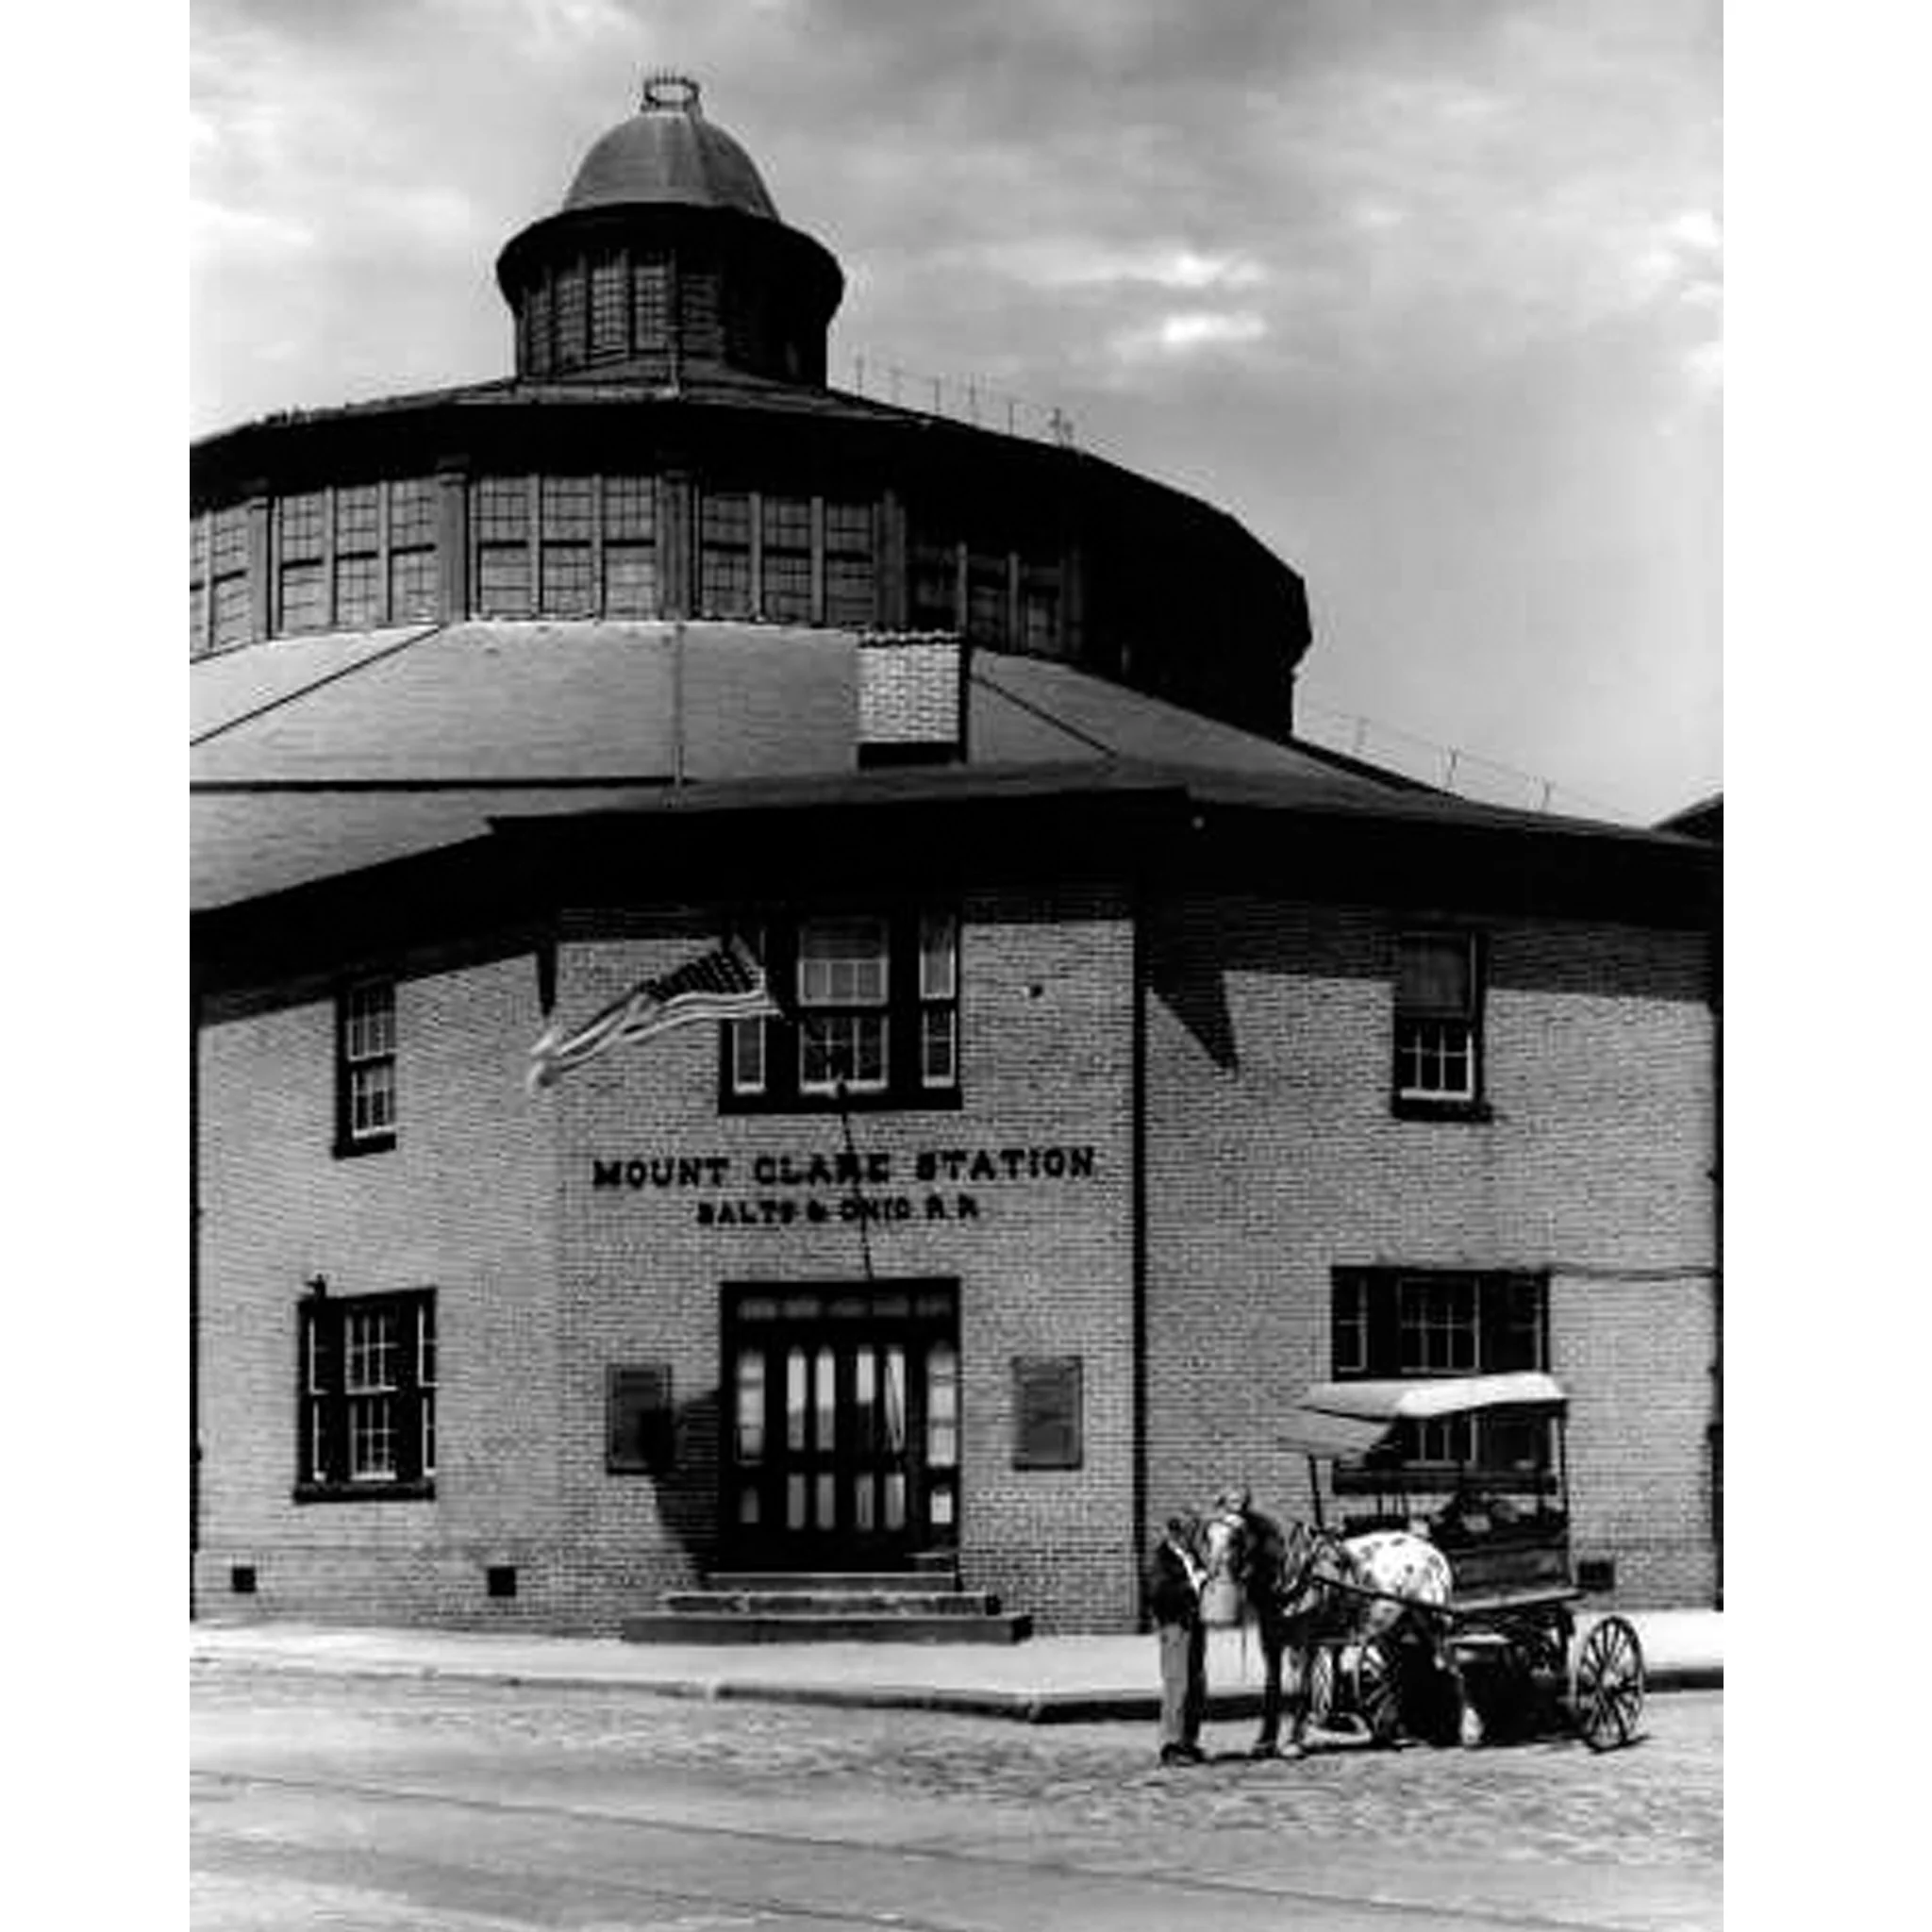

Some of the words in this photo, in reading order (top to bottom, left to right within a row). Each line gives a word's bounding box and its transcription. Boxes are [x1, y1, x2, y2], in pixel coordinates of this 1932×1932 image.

[593, 1158, 729, 1189] MOUNT
[754, 1153, 890, 1185] CLARE
[915, 1146, 1094, 1181] STATION
